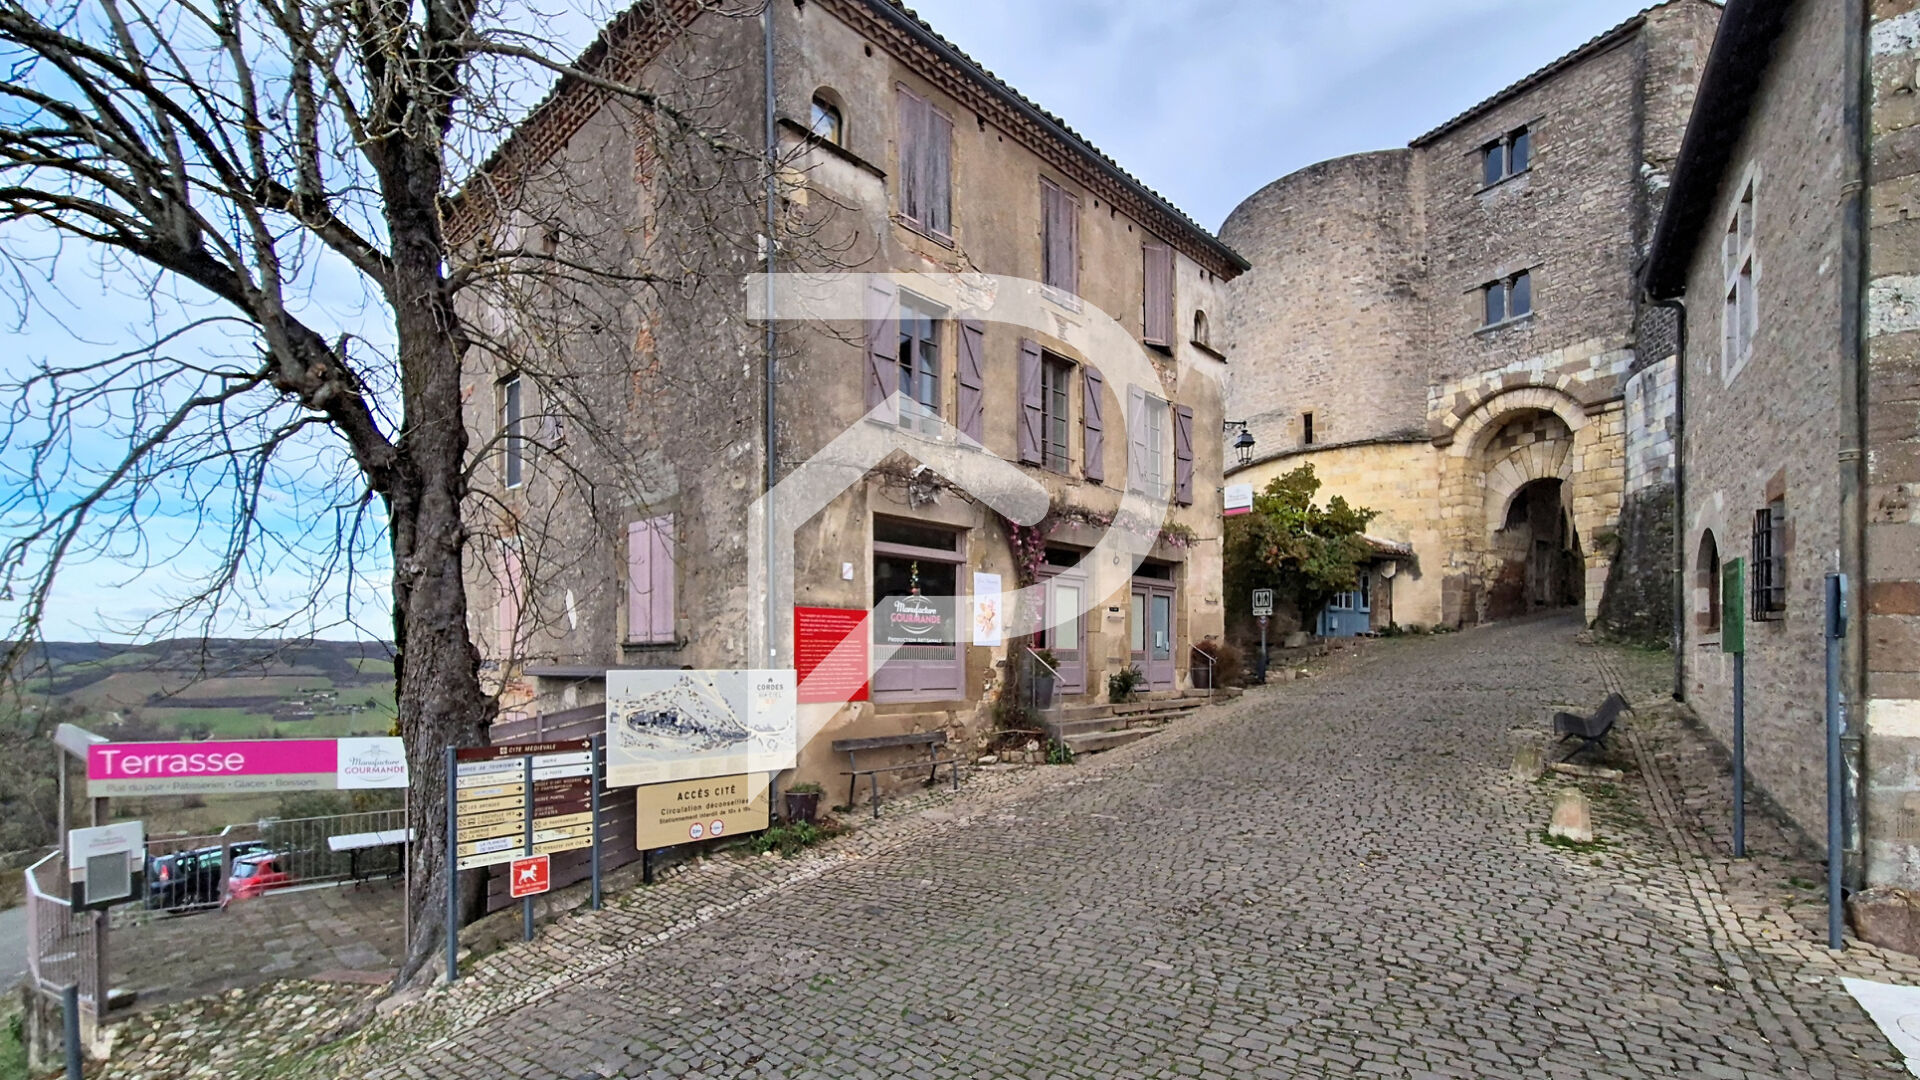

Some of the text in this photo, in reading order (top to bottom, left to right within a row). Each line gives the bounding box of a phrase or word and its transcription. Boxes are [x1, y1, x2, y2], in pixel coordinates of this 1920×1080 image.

[894, 600, 937, 615] Manufacture
[890, 612, 941, 624] GOURMANDE
[97, 750, 245, 775] Terrasse
[348, 756, 400, 768] Manufacture
[344, 765, 404, 775] GOURMANDE
[129, 783, 142, 791] du
[144, 783, 164, 793] jour
[234, 779, 267, 788] Glaces
[275, 778, 318, 787] Boissons
[677, 785, 736, 800] ACCÈS CITÉ
[661, 798, 749, 816] Circulation déconseillée
